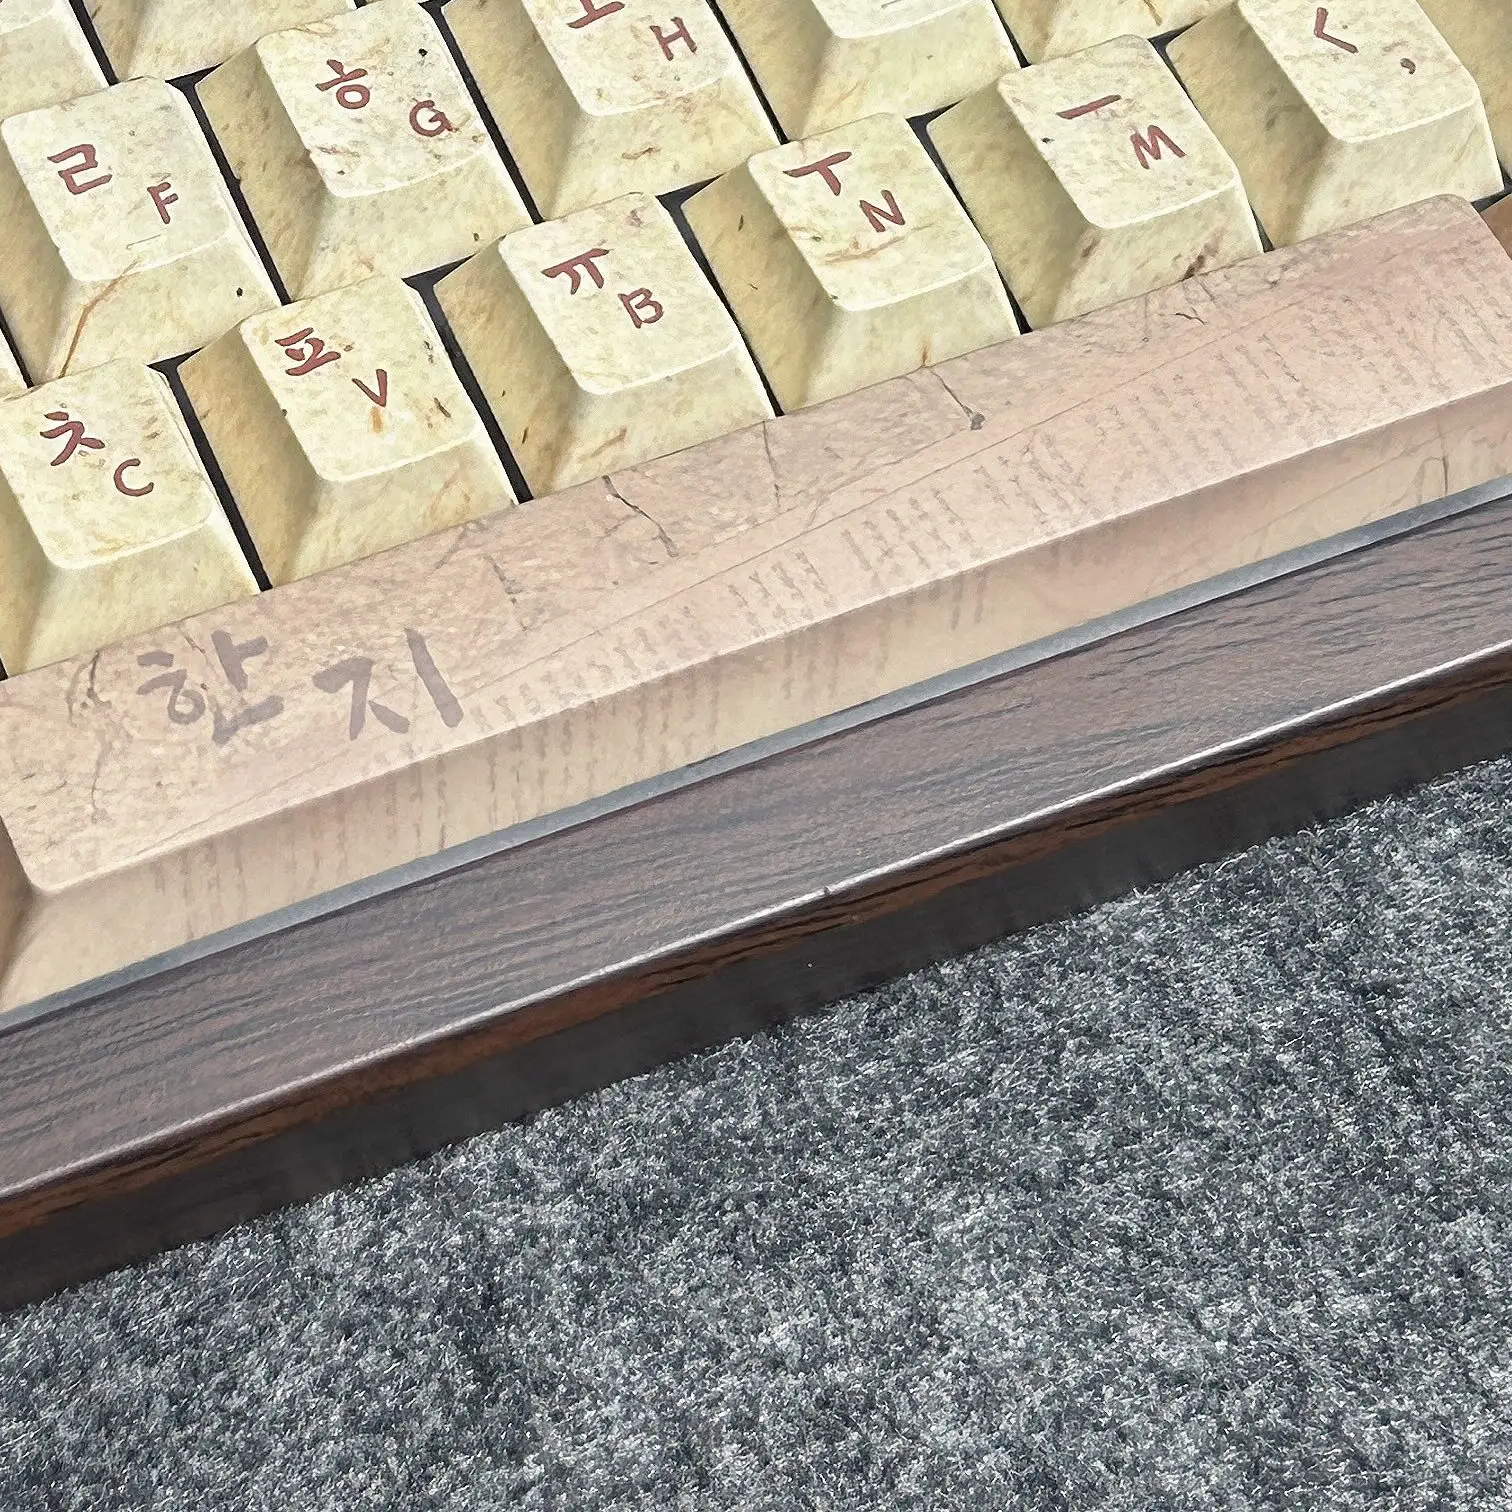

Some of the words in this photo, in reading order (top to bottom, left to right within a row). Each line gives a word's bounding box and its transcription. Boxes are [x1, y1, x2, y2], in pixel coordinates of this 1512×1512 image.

[650, 16, 697, 62] H
[1313, 6, 1359, 55] <
[1399, 57, 1416, 75] ,
[409, 100, 453, 138] G
[1130, 124, 1187, 170] M
[147, 182, 179, 224] F
[859, 188, 907, 233] N
[617, 287, 664, 328] B
[351, 369, 388, 407] V
[113, 459, 155, 497] C
[137, 627, 464, 743] 한지
